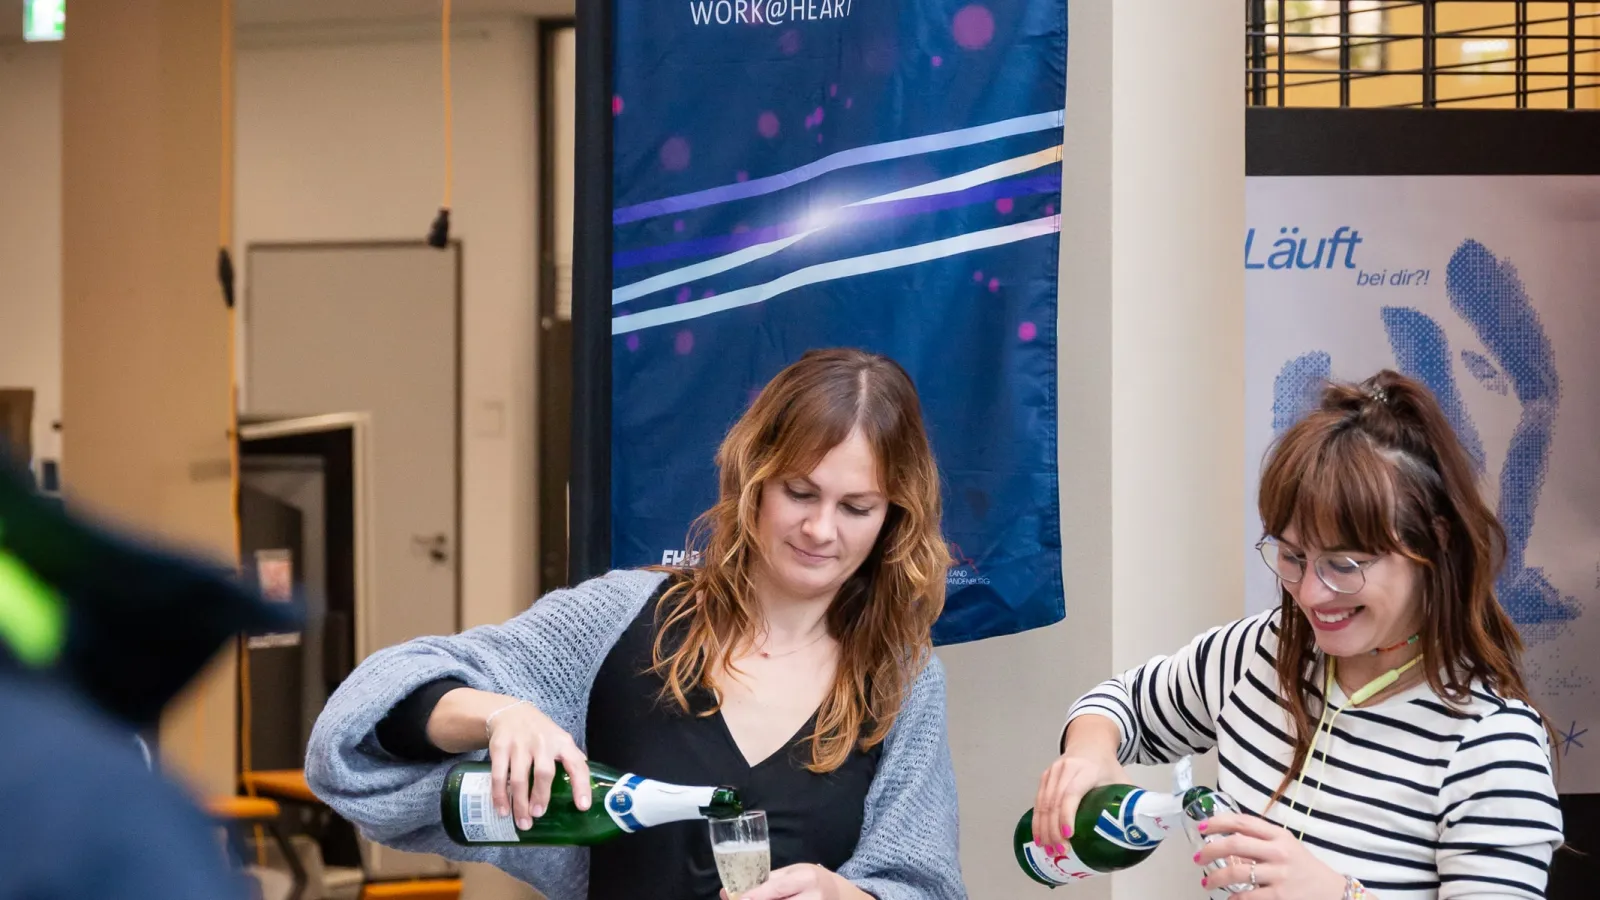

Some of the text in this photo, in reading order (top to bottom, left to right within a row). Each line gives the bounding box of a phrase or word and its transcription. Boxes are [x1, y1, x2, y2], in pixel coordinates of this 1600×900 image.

[1244, 226, 1363, 270] Läuft
[1356, 270, 1430, 286] bei dir?!
[946, 577, 991, 586] RANDENBURG
